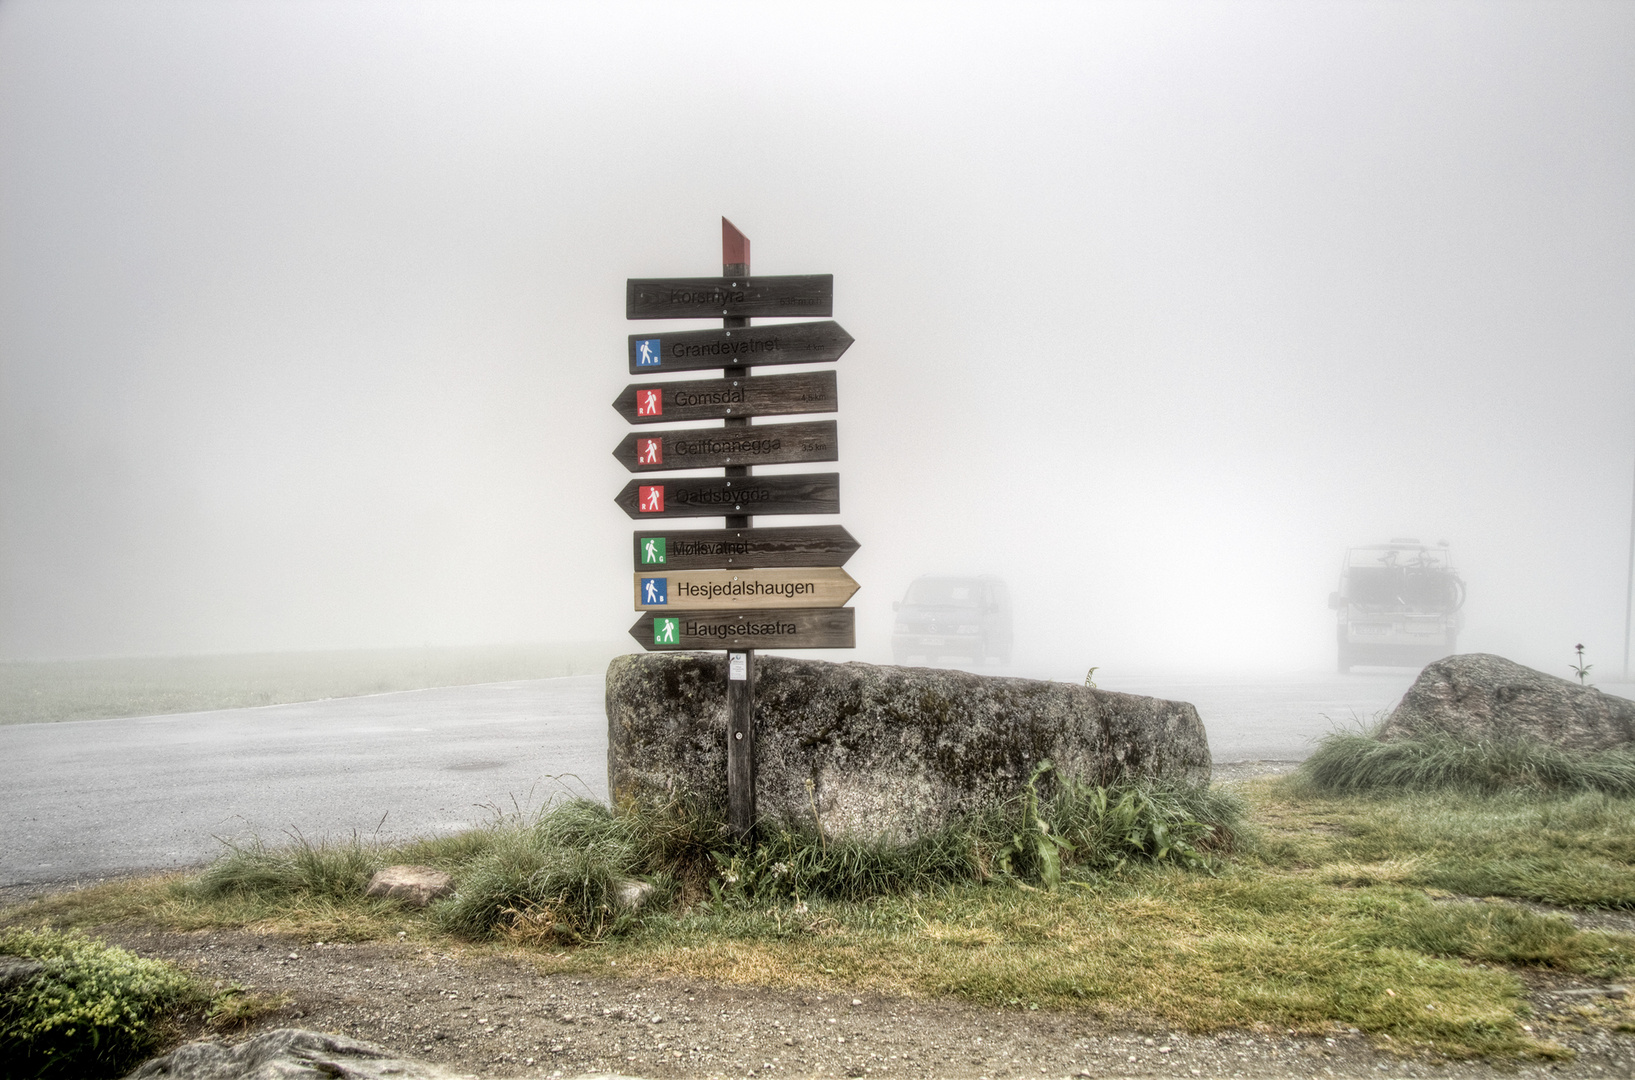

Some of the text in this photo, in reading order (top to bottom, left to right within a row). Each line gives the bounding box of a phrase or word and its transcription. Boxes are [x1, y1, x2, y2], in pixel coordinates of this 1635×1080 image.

[670, 288, 744, 306] Korsmyra
[672, 337, 780, 357] Grandevatnet
[675, 387, 745, 406] Gomsdal
[801, 443, 827, 452] 3,5 km
[673, 540, 749, 556] Møllsvatnet
[678, 581, 815, 599] Hesjedalshaugen
[686, 621, 797, 639] Haugsetsætra
